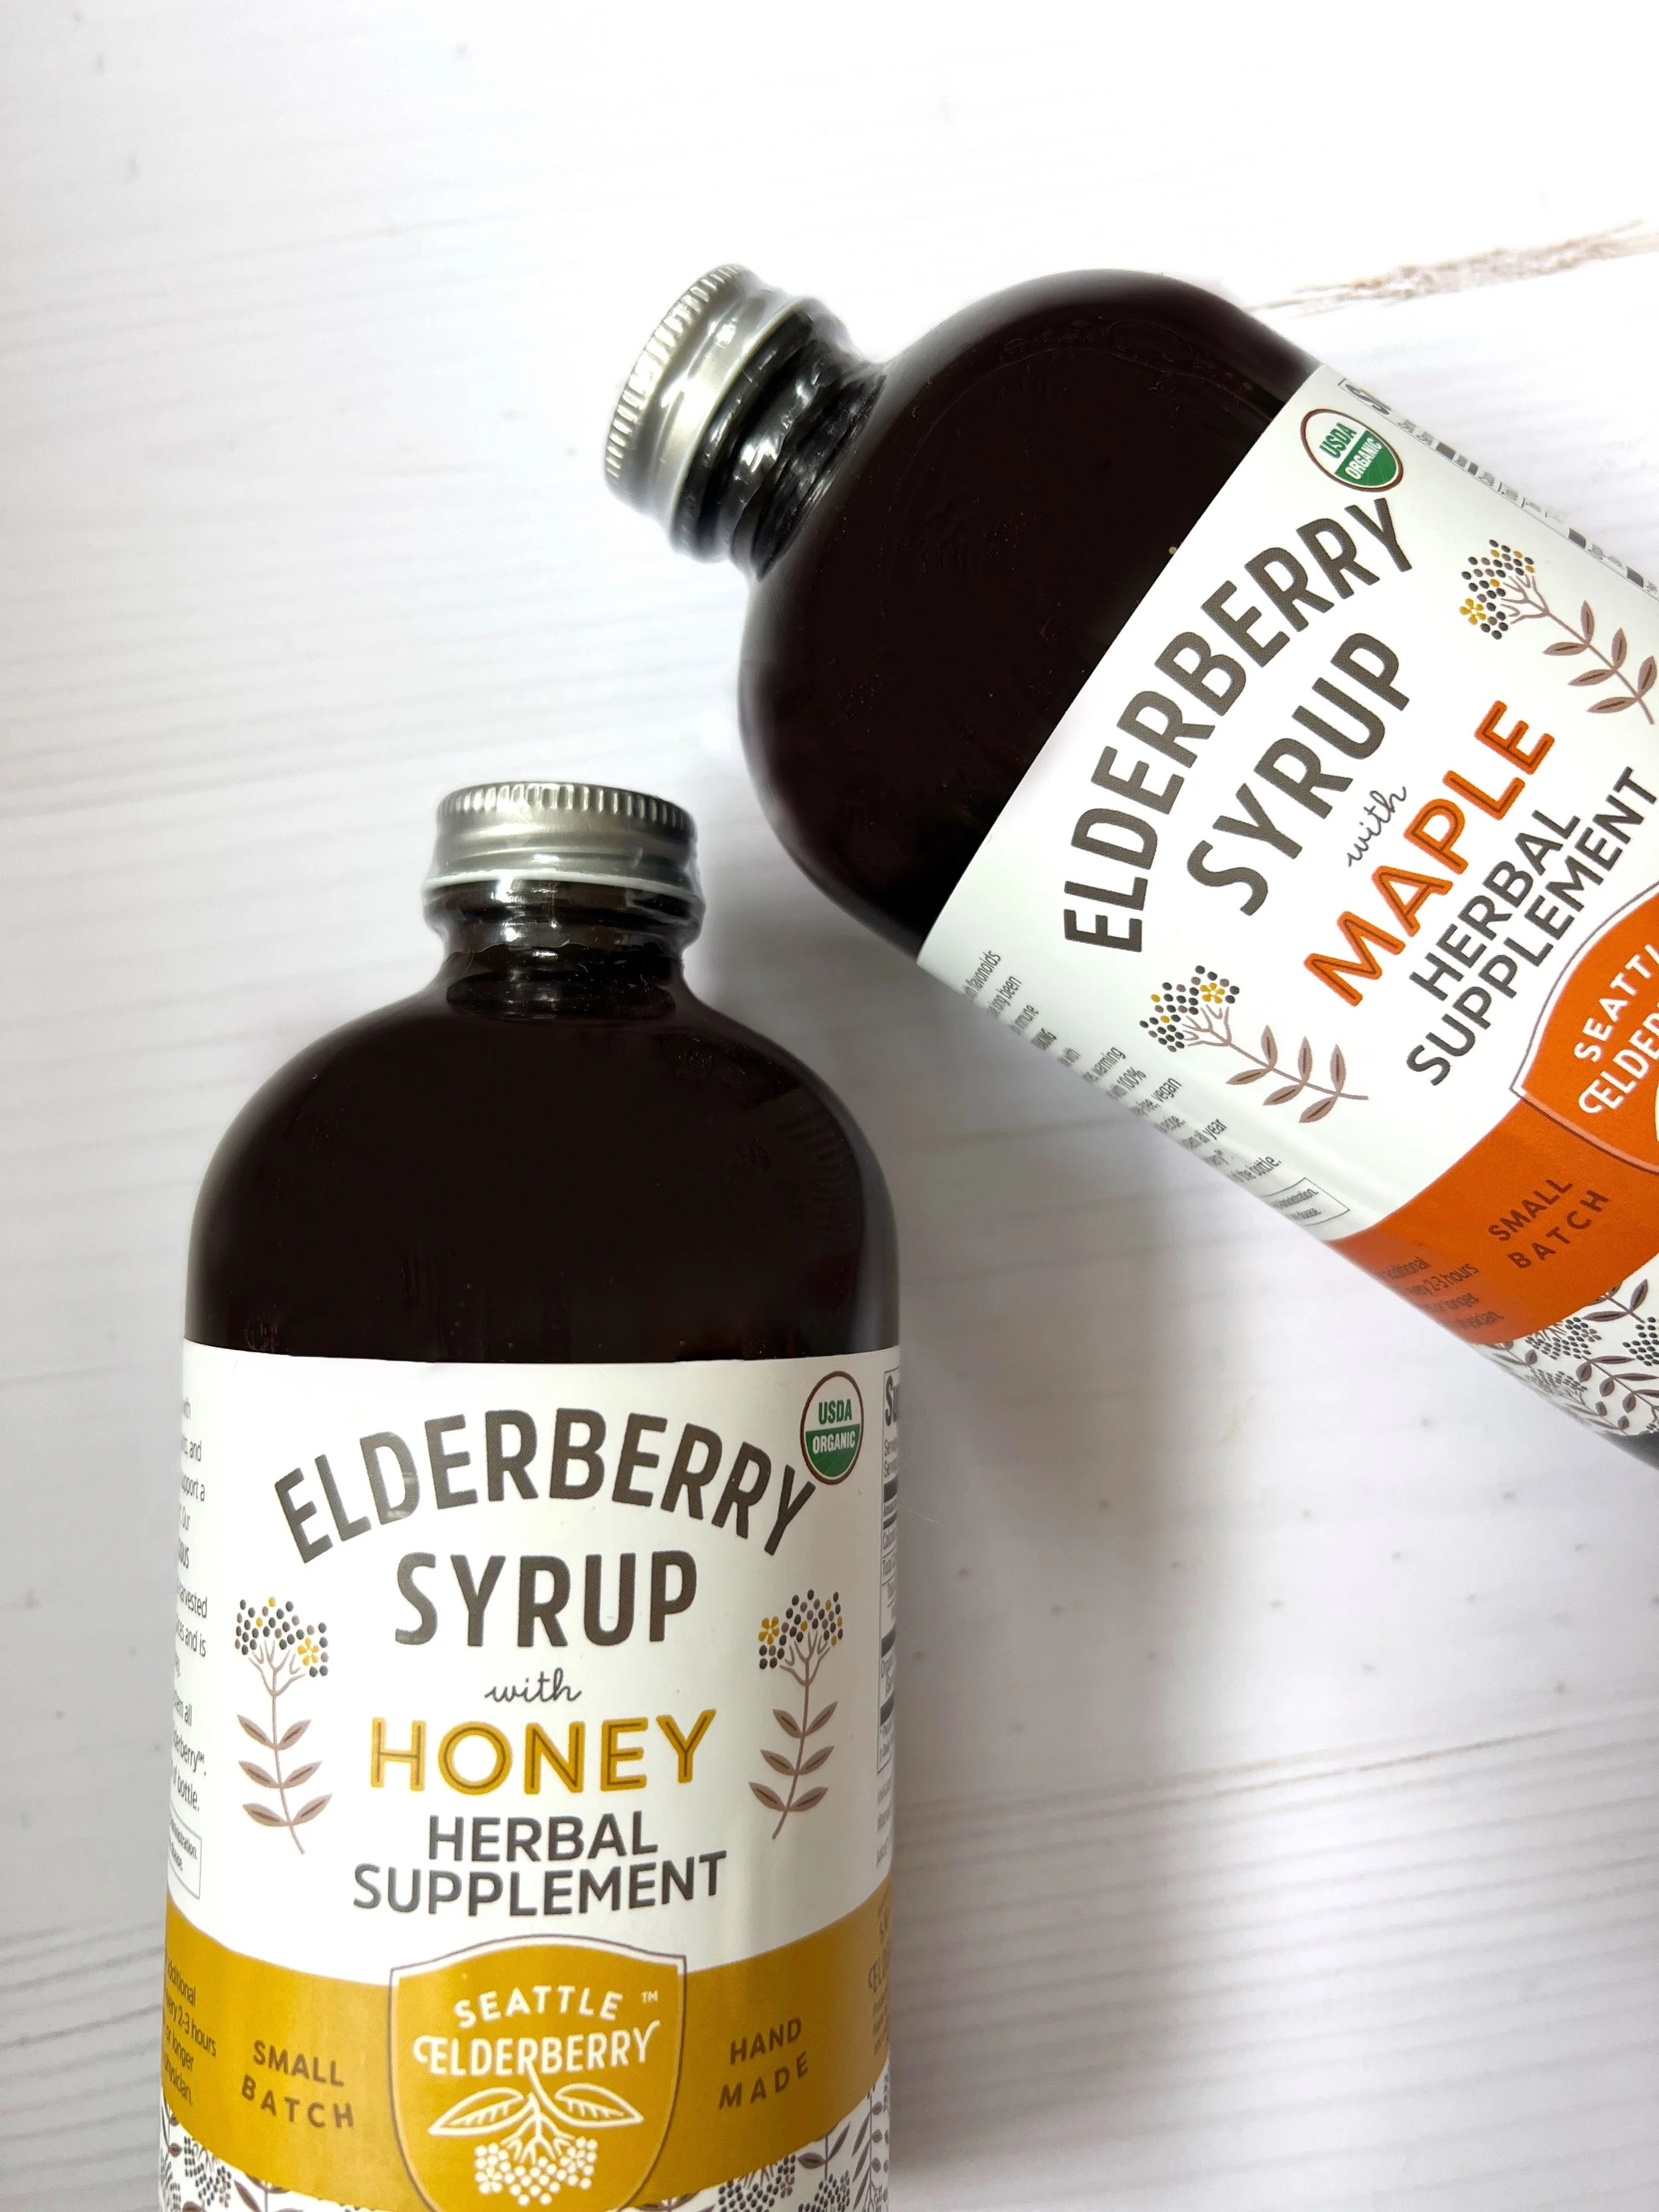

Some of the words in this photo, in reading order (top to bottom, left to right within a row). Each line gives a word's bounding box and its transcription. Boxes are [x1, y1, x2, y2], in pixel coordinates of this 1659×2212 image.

[1319, 422, 1356, 459] USDA
[1345, 437, 1382, 480] ORGANIC
[1064, 498, 1413, 952] ELDERBERRY
[1187, 632, 1409, 916] SYRUP
[1348, 786, 1406, 867] with
[1305, 700, 1554, 1007] MAPLE
[1406, 767, 1657, 1086] SUPPLEMENT
[1409, 810, 1580, 1001] HERBAL
[995, 976, 1022, 1000] been
[1116, 1066, 1146, 1091] 100%
[1151, 1077, 1182, 1102] vegan
[1202, 1118, 1227, 1140] year
[1246, 1155, 1281, 1177] bottle.
[1488, 1179, 1573, 1242] SMALL
[1506, 1189, 1609, 1269] BATCH
[1440, 1263, 1479, 1286] hours
[818, 1398, 853, 1425] USDA
[812, 1430, 856, 1455] ORGANIC
[274, 1407, 816, 1564] ELDERBERRY
[394, 1550, 698, 1648] SYRUP
[199, 1633, 206, 1658] is
[484, 1667, 583, 1702] with
[369, 1708, 717, 1796] HONEY
[177, 1768, 200, 1811] bottle.
[428, 1810, 658, 1863] HERBAL
[352, 1850, 727, 1917] SUPPLEMENT
[178, 2004, 190, 2034] 2-3
[191, 2018, 217, 2057] hours
[454, 1985, 623, 2029] SEATTLE
[172, 2030, 194, 2072] longer
[253, 2039, 344, 2088] SMALL
[413, 2020, 660, 2076] ELDERBERRY
[730, 2018, 802, 2066] HAND
[241, 2074, 354, 2128] BATCH
[718, 2051, 809, 2110] MADE
